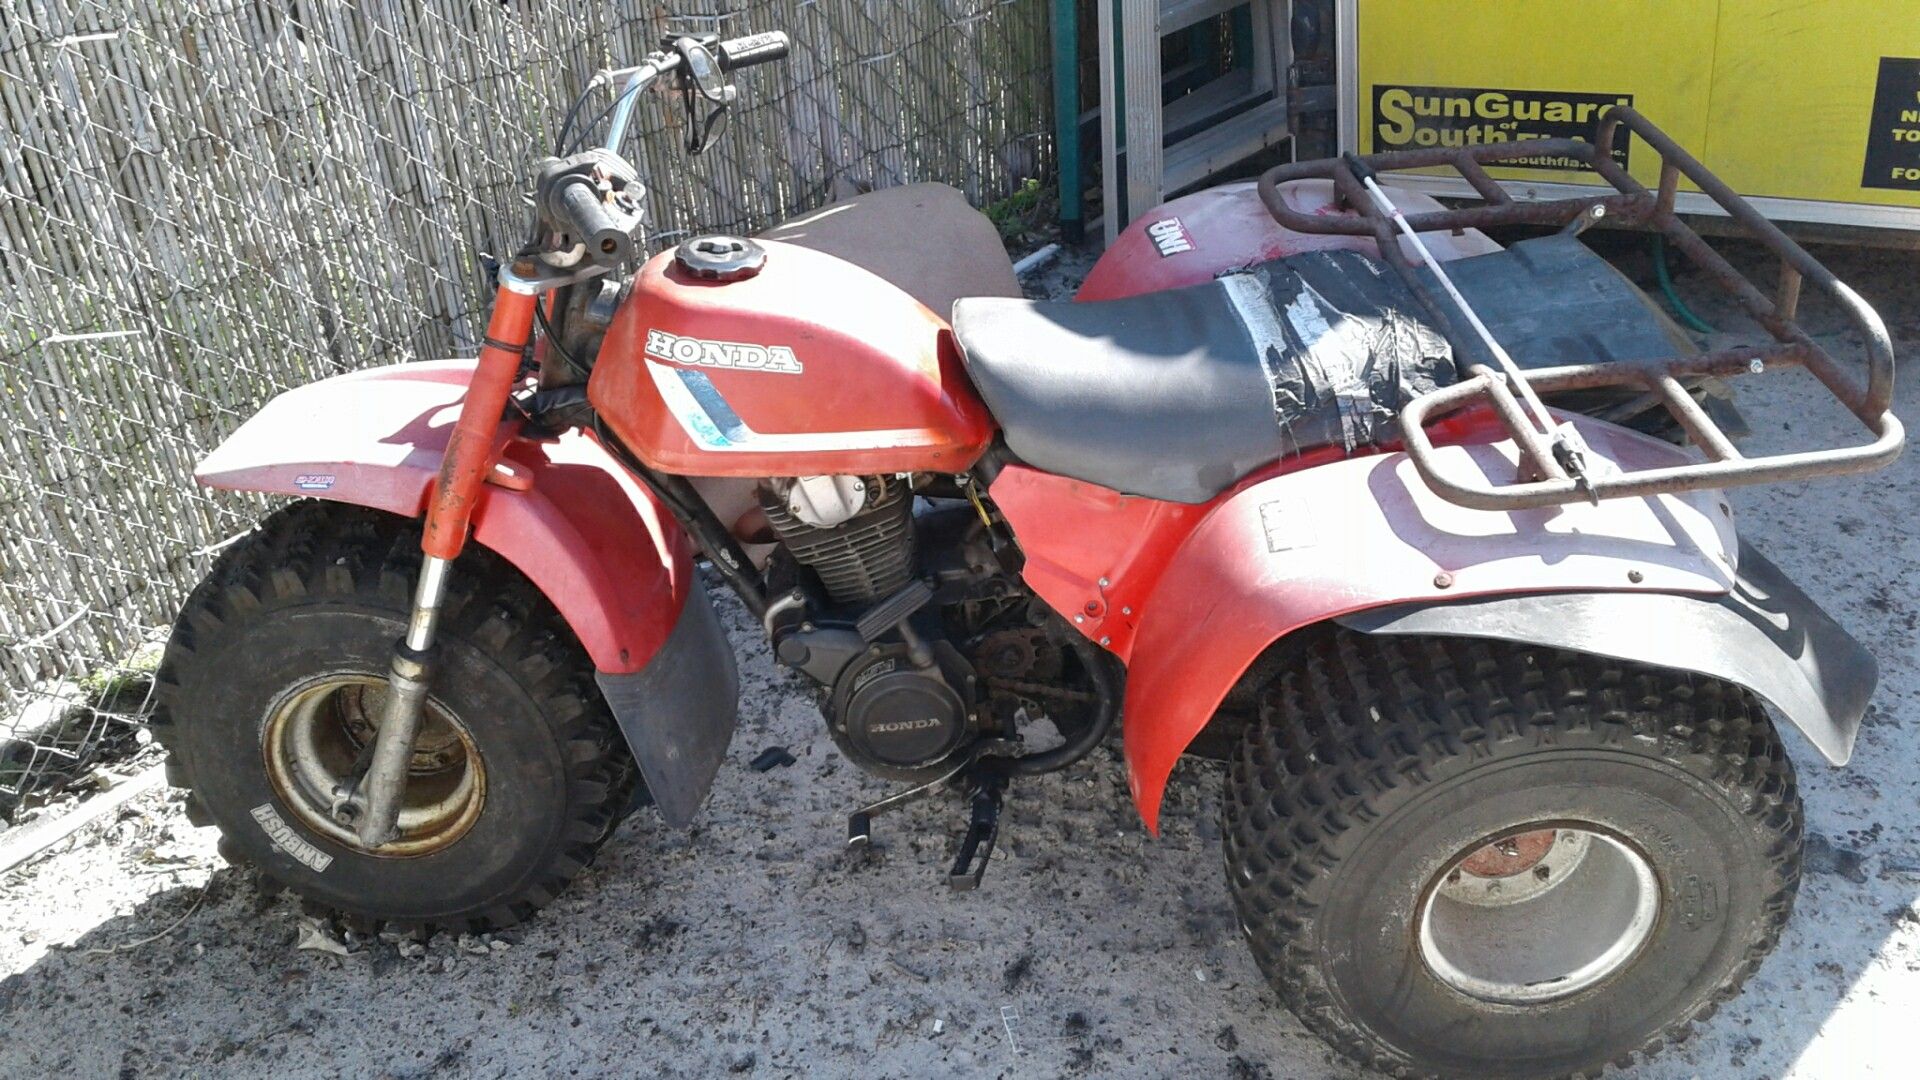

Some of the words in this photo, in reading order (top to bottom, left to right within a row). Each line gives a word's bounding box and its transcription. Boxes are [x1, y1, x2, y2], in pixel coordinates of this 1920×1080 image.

[1901, 110, 1920, 122] N
[1500, 121, 1518, 131] of
[646, 330, 801, 373] HONDA
[870, 718, 942, 732] HONDA
[251, 803, 333, 872] AMBUSH
